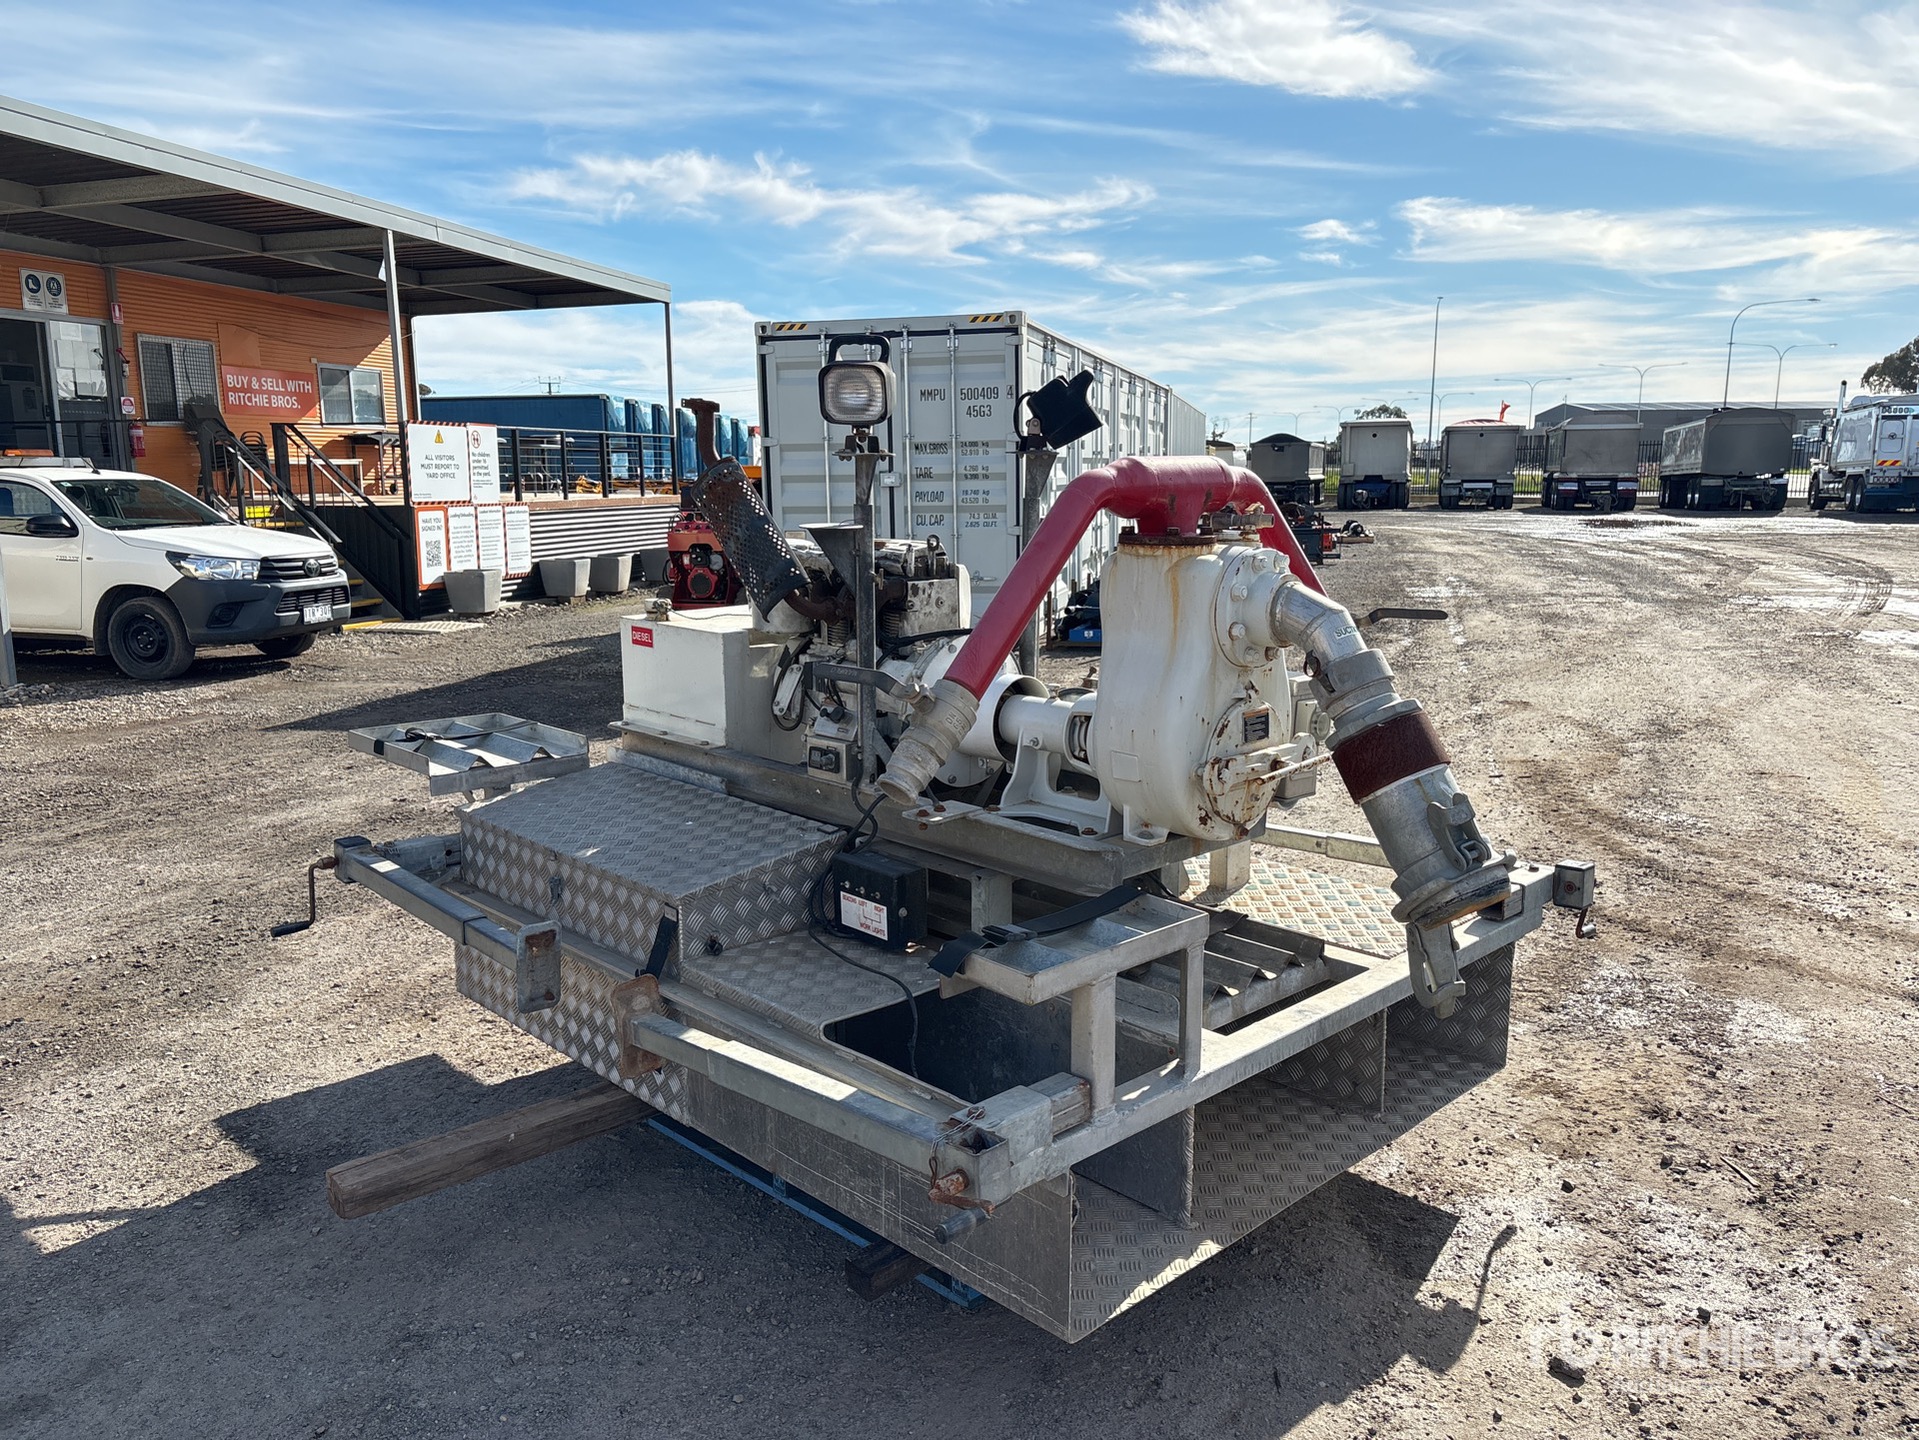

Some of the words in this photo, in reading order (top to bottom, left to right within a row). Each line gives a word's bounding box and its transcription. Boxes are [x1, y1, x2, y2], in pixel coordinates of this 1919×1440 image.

[226, 374, 248, 389] BUY
[251, 376, 259, 390] &
[261, 377, 285, 392] SELL
[286, 379, 312, 393] WITH
[228, 391, 269, 407] RITCHIE
[271, 394, 301, 409] BROS.
[919, 388, 946, 402] MMPU
[960, 386, 999, 401] 500409
[966, 404, 992, 418] 45G3
[982, 448, 989, 456] lb
[914, 466, 934, 479] TARE
[981, 465, 989, 473] kg
[914, 490, 945, 503] PAYLOAD
[633, 630, 652, 643] DIESEL
